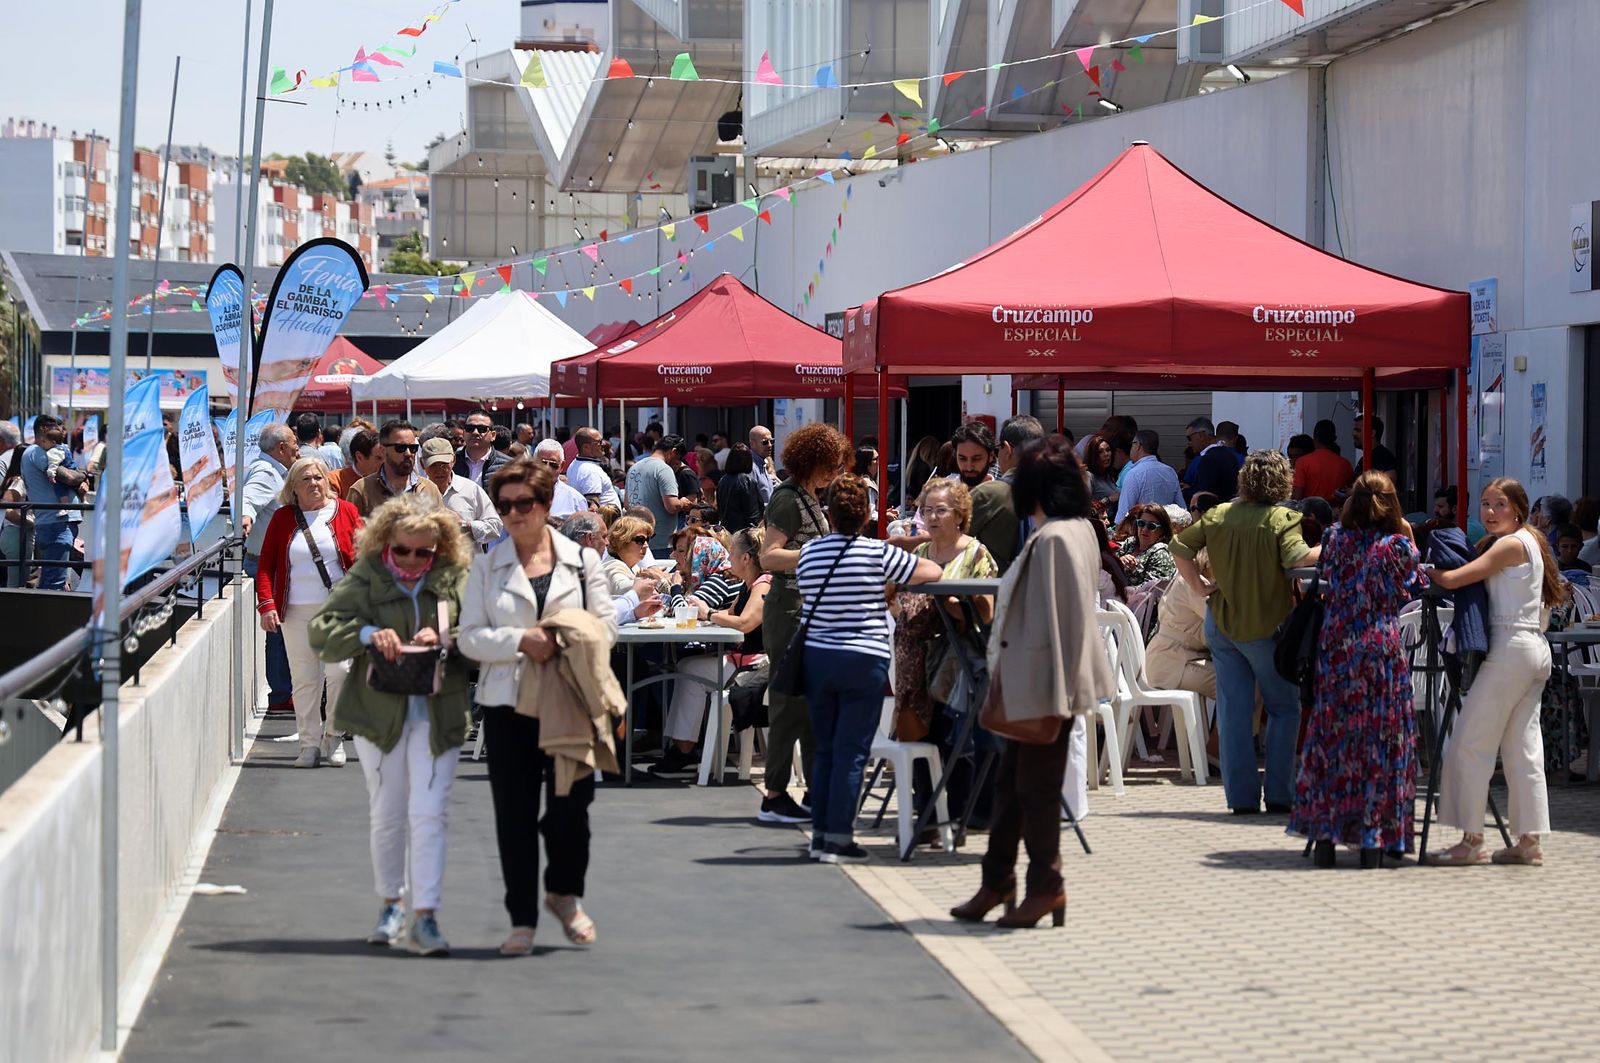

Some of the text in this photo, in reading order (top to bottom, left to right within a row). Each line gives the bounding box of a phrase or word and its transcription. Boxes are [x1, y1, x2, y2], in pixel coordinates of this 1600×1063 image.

[297, 255, 358, 292] Feria
[299, 284, 331, 298] DE LA
[287, 292, 338, 309] GAMBA Y
[277, 300, 343, 320] EL MARISCO
[992, 304, 1094, 326] Cruzcampo
[1252, 304, 1355, 326] Cruzcampo
[274, 310, 332, 336] Huelva
[1004, 327, 1081, 341] ESPECIAL
[1264, 328, 1344, 342] ESPECIAL
[657, 364, 712, 376] Cruzcampo
[795, 364, 843, 376] Cruzcamp
[664, 376, 706, 384] ESPECIAL
[801, 376, 844, 384] ESPECIAL
